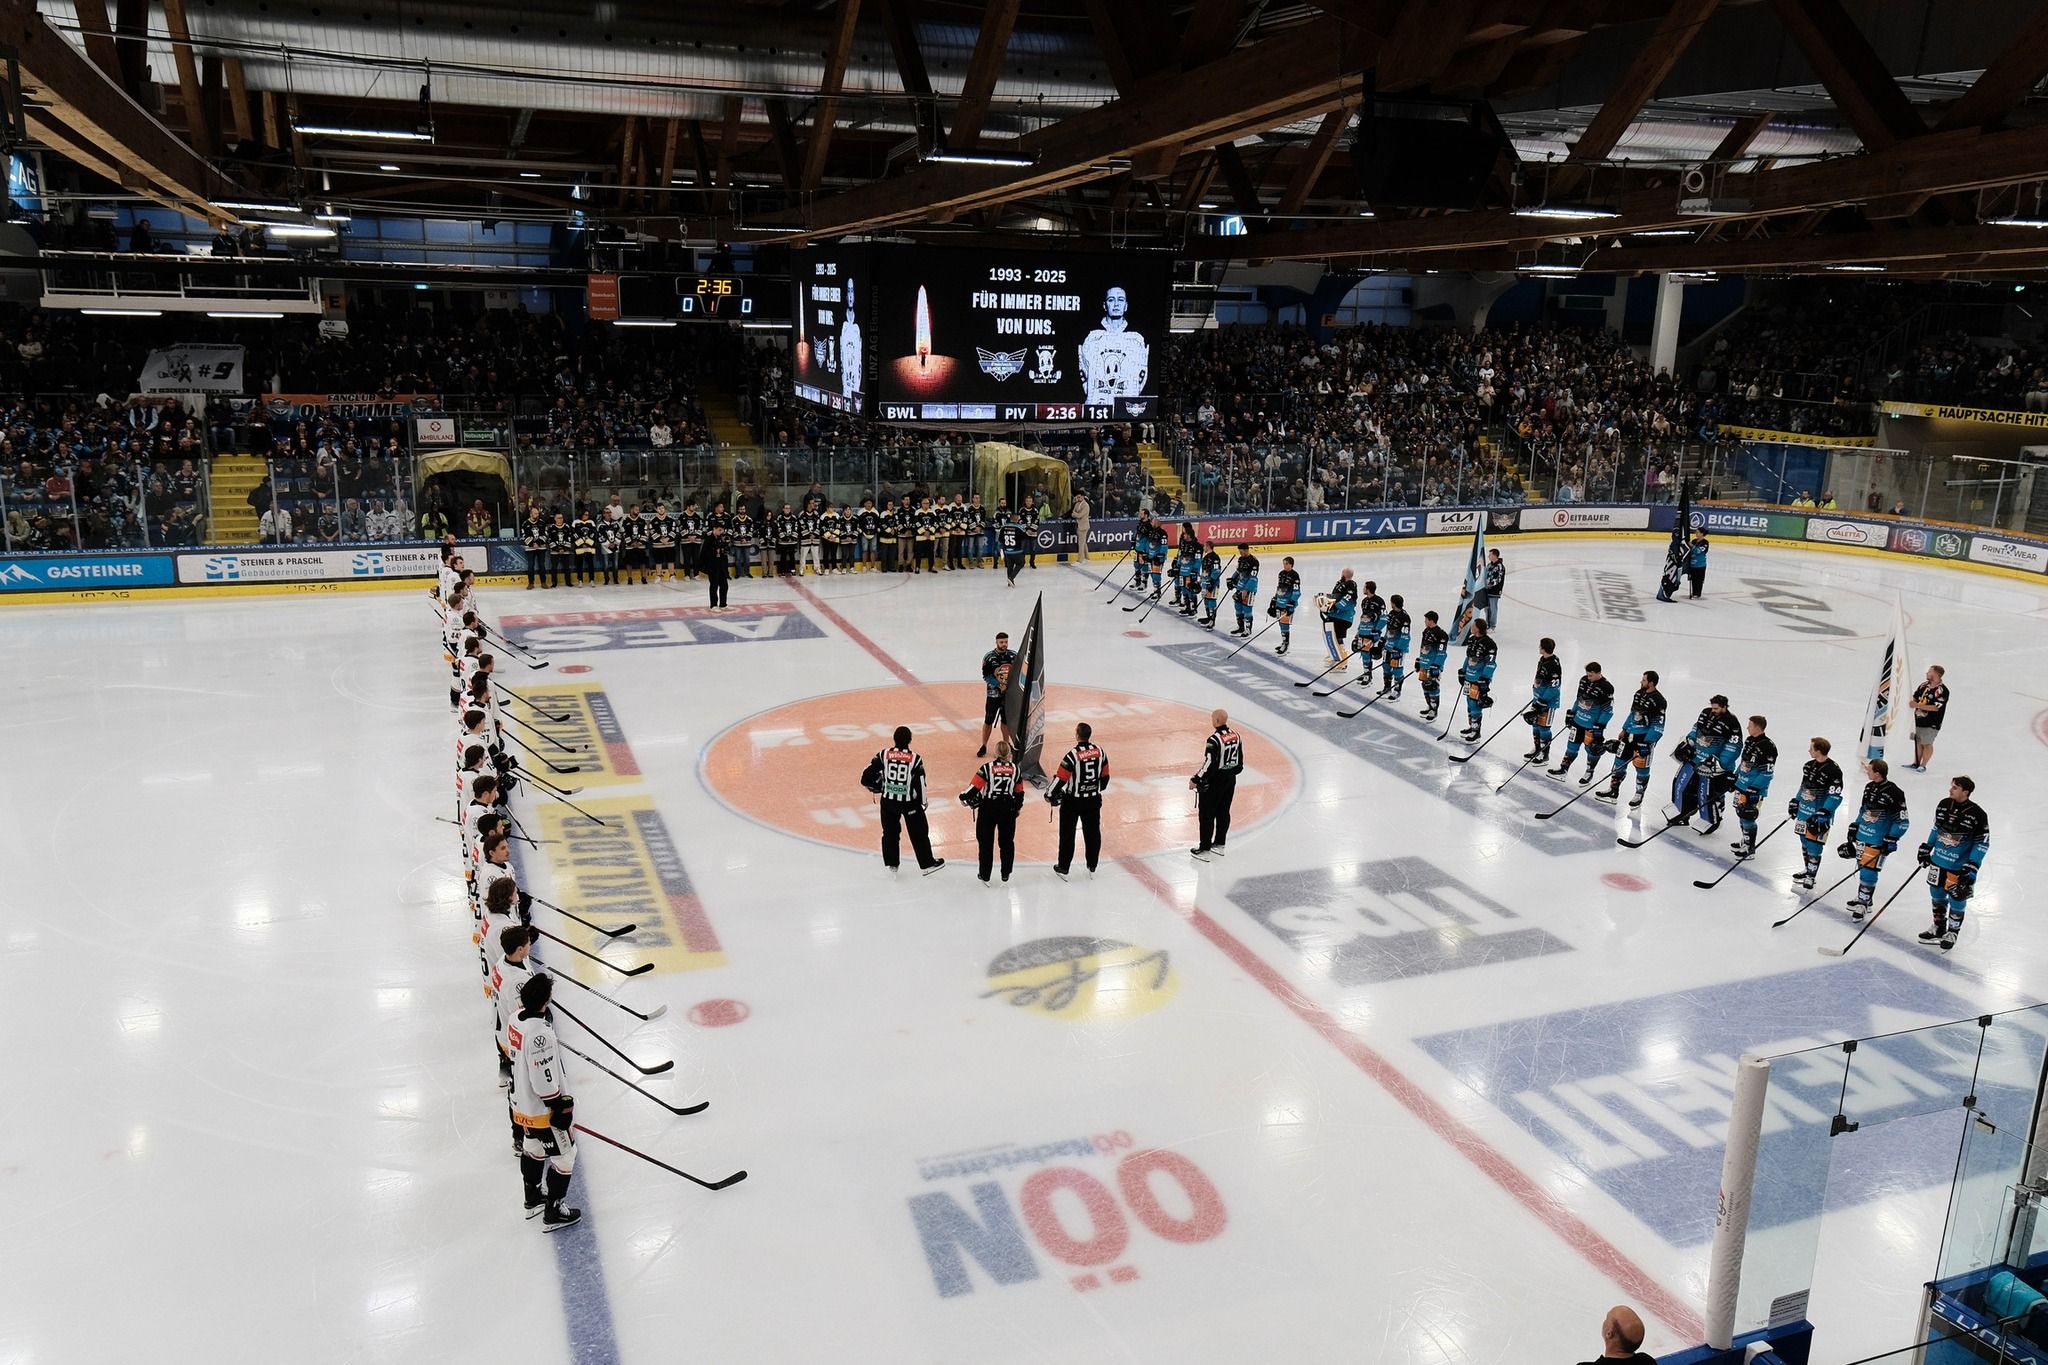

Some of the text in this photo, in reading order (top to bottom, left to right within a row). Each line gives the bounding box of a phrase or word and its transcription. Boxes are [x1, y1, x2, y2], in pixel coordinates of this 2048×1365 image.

[19, 161, 37, 195] AG
[988, 268, 1022, 281] 1993
[1034, 270, 1067, 284] 2025
[697, 280, 732, 295] 2:36
[682, 297, 694, 312] 0
[741, 298, 752, 313] 0
[972, 289, 1080, 312] FÜR IMMER EINER
[996, 317, 1056, 336] VON UNS.
[327, 394, 377, 402] FANCLUB
[300, 403, 402, 418] OVERTIME
[887, 407, 918, 419] BWL
[1005, 407, 1027, 420] PIV
[1046, 406, 1077, 420] 2:36
[1088, 406, 1109, 420] 1st
[1938, 406, 2023, 425] HAUPTSACHE
[420, 433, 454, 441] AMBULANZ
[1305, 516, 1417, 537] LINZ AG
[1708, 513, 1768, 528] BICHLER
[1207, 523, 1281, 541] Linzer Bier
[1440, 525, 1473, 533] AUTOEDER
[1004, 534, 1016, 547] 85
[1058, 531, 1134, 545] Lin Airport
[385, 554, 419, 563] STEINER
[420, 553, 427, 562] &
[1981, 544, 2038, 561] PRINT WEAR
[241, 556, 324, 568] STEINER & PRASCHL
[385, 562, 440, 574] Gebäuderein
[47, 563, 144, 579] GASTEINER
[241, 566, 326, 578] Gebäudereinigung
[522, 615, 790, 651] AFS
[1551, 679, 1560, 688] 23
[1215, 664, 1341, 724] LIWEST
[819, 696, 1152, 743] Steinach
[1729, 735, 1739, 744] 33
[1225, 744, 1238, 762] 72
[888, 762, 909, 782] 68
[1085, 761, 1096, 780] 5
[994, 776, 1012, 792] 27
[1828, 785, 1841, 795] 84
[540, 1055, 554, 1066] vkw
[544, 1068, 553, 1083] 9
[906, 1147, 1229, 1301] OÖN
